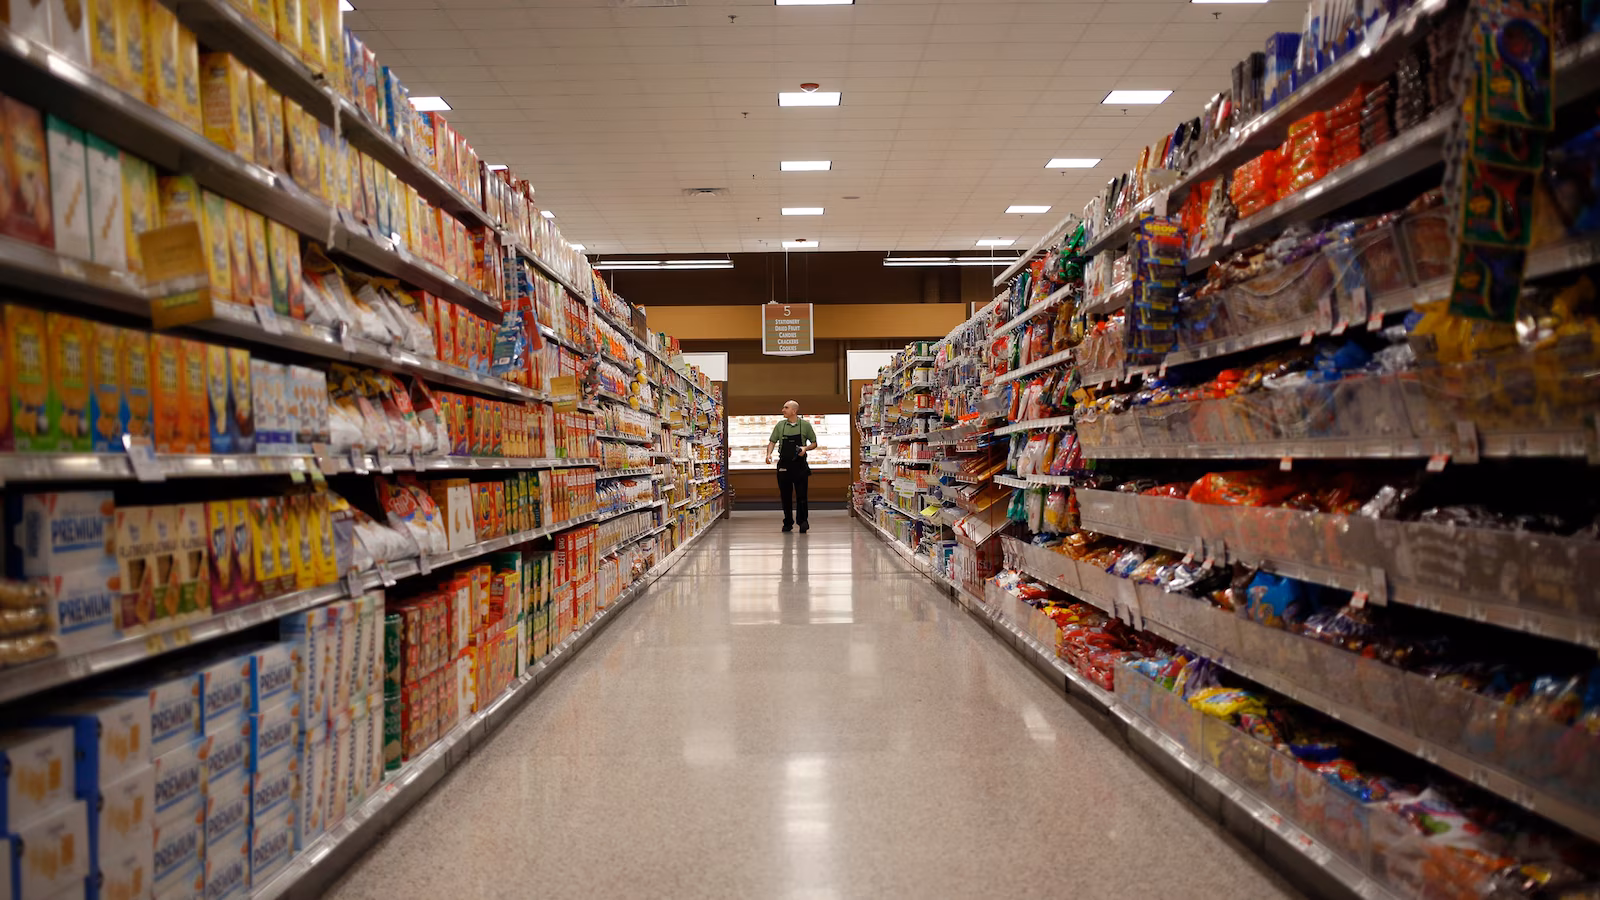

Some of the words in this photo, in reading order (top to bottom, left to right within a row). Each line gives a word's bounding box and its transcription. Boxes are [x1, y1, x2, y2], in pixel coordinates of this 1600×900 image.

[783, 305, 791, 316] 5
[51, 517, 104, 543] PREMIUM
[59, 595, 112, 624] PREMIUM
[152, 702, 192, 736] PREMIUM
[155, 768, 198, 805] PREMIUM
